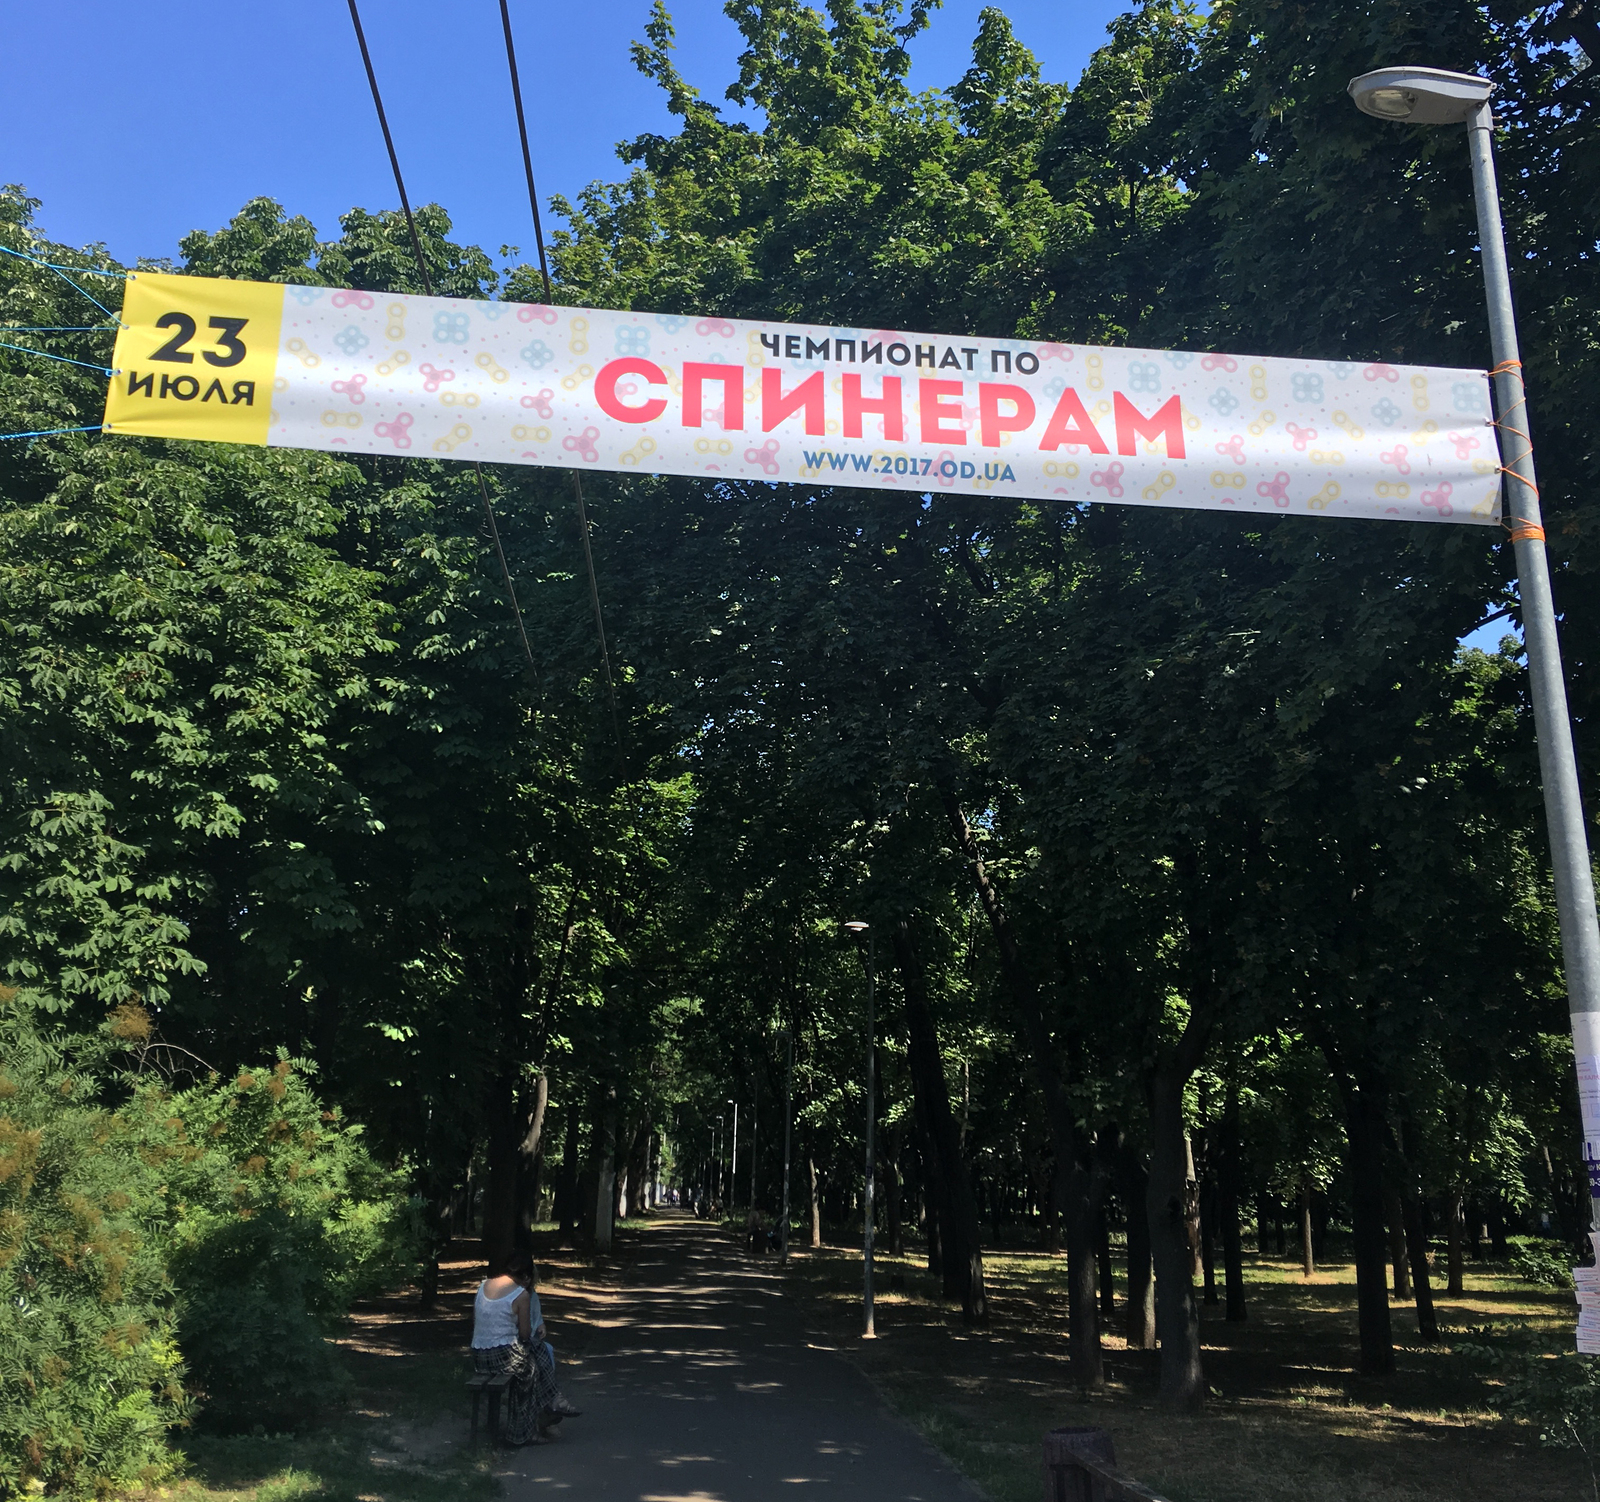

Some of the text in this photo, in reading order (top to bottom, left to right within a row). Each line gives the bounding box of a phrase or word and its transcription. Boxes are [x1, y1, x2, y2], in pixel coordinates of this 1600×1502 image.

[148, 311, 250, 368] 23
[760, 332, 1040, 375] ЧЕМПИОНАТ ПО
[127, 371, 256, 407] ИЮЛЯ
[594, 357, 1186, 460] СПИНЕРАМ
[802, 450, 1016, 483] WWW.2017.OD.UA
